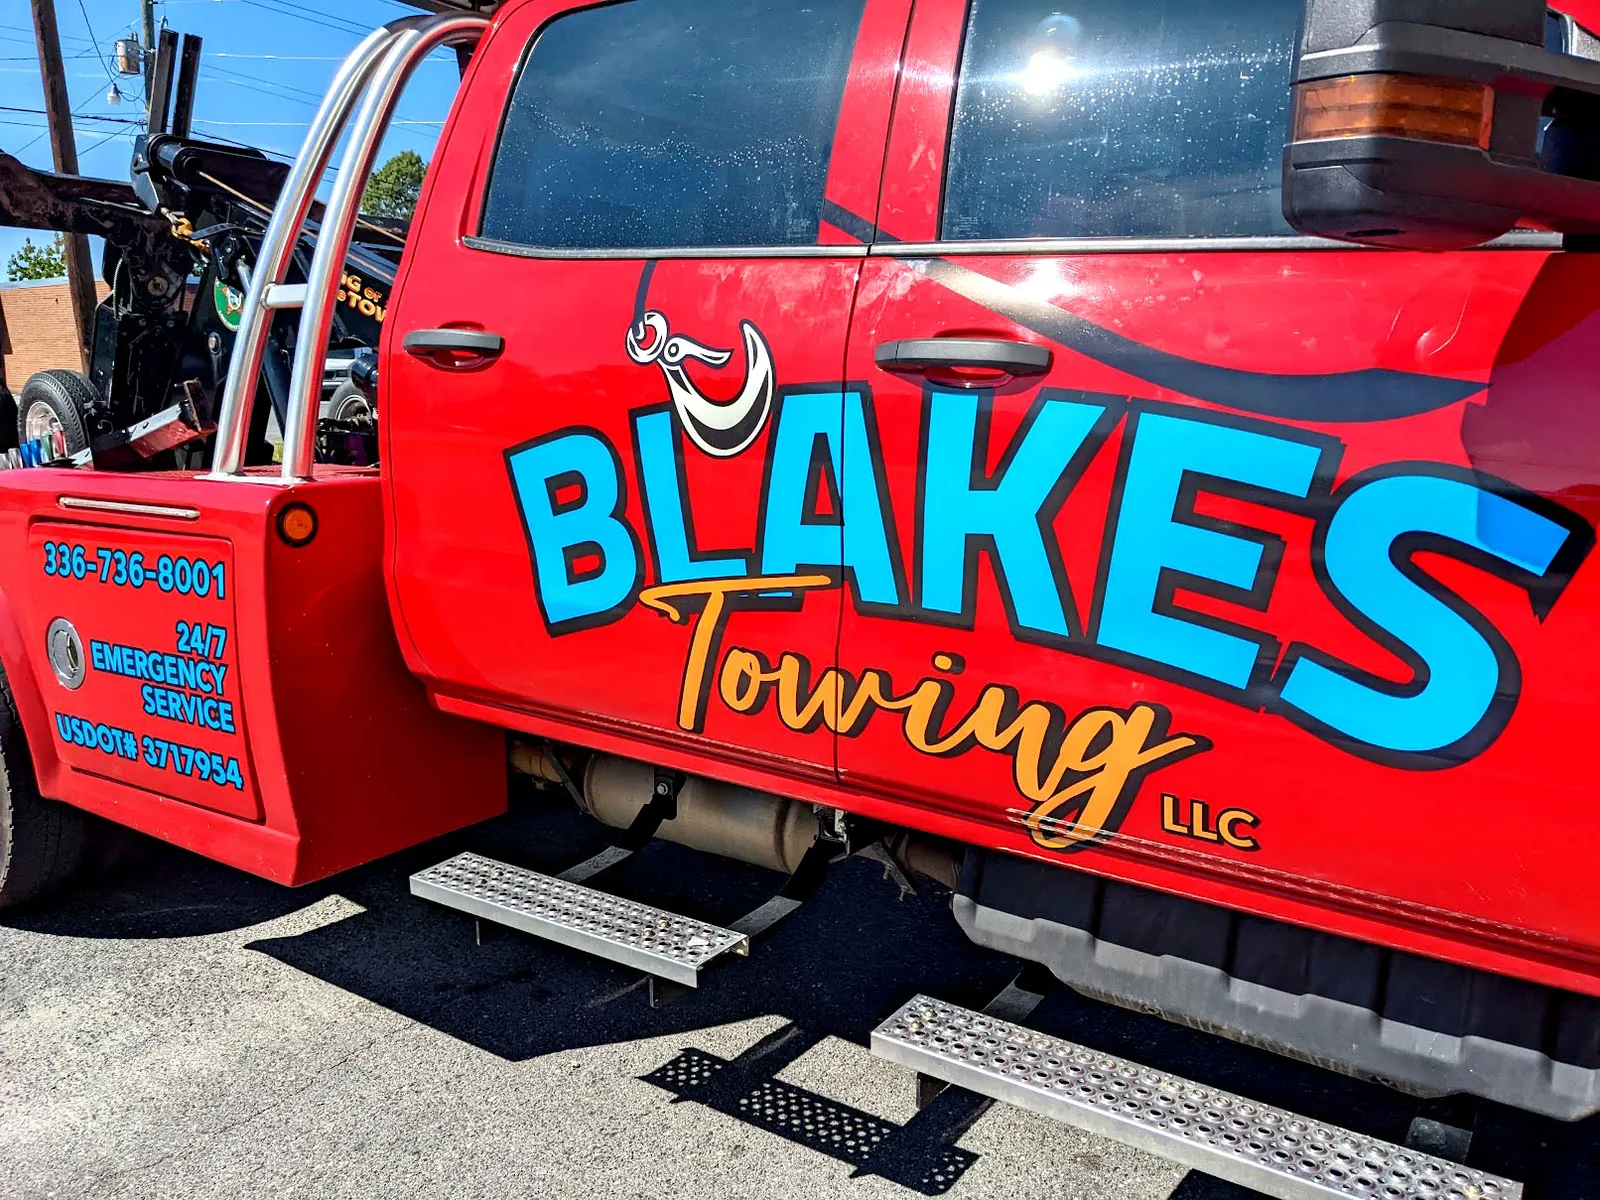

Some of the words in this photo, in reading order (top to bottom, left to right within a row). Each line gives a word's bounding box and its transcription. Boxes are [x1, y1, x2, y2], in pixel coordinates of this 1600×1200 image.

[43, 541, 226, 599] 336-736-8001
[507, 382, 1594, 768] BLAKES
[90, 640, 227, 696] EMERGENCY
[175, 620, 227, 659] 24/7
[141, 684, 236, 733] SERVICE
[640, 574, 1210, 848] Towing
[55, 712, 139, 760] USDOT#
[141, 735, 244, 790] 3717954
[1161, 793, 1261, 851] LLC
